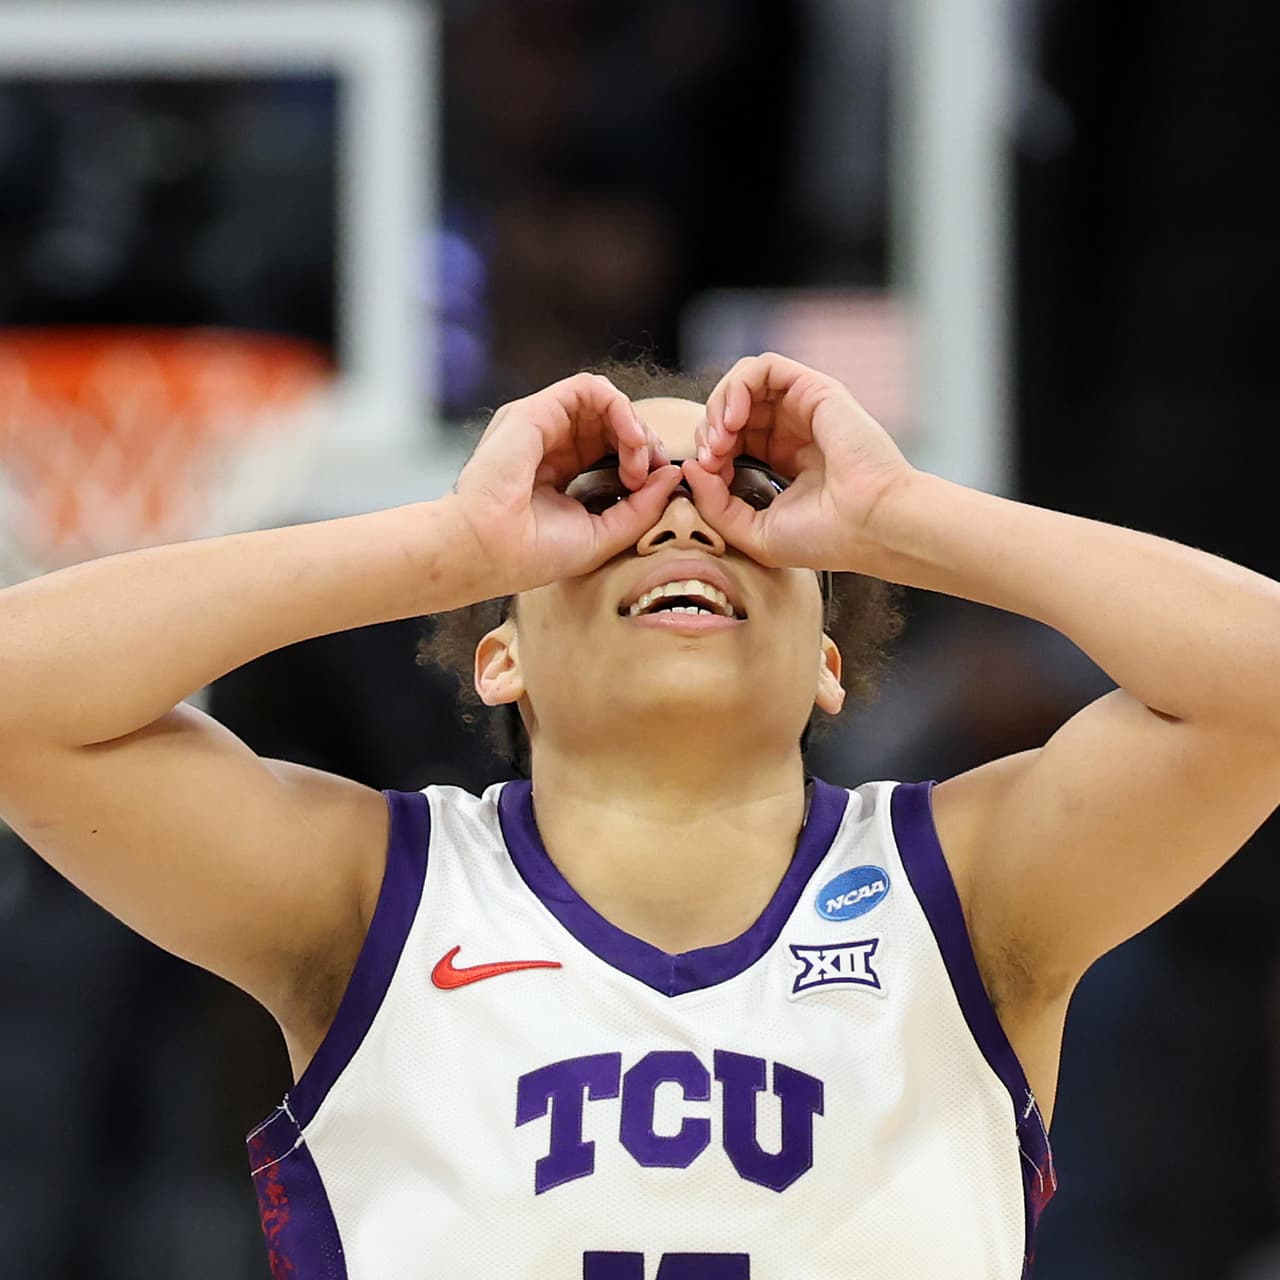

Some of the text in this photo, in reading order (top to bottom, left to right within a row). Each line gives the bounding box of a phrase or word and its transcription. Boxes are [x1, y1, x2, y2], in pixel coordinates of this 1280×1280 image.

[825, 879, 885, 914] NCAA
[789, 938, 881, 993] XII
[515, 1048, 825, 1195] TCU
